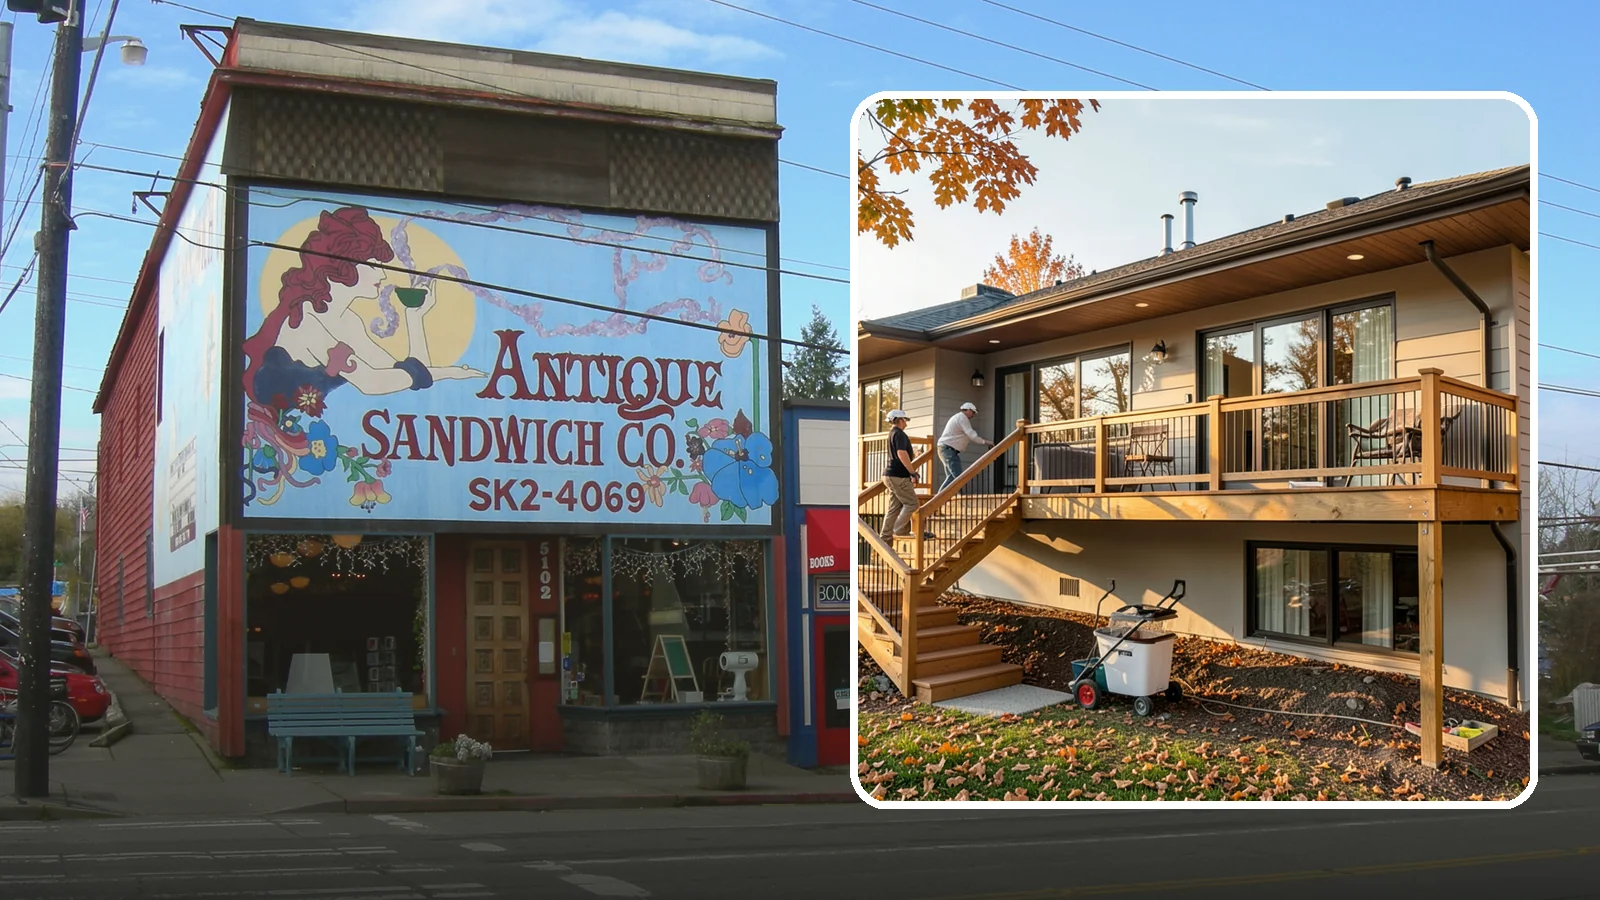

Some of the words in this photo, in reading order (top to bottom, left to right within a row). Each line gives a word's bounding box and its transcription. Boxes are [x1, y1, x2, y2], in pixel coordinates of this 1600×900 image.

[476, 329, 723, 420] ANTIQUE
[361, 409, 604, 467] SANDWICH
[617, 422, 684, 468] CO.
[468, 477, 645, 513] SK2-4069
[540, 542, 551, 600] 5102
[809, 555, 835, 569] BOOKS
